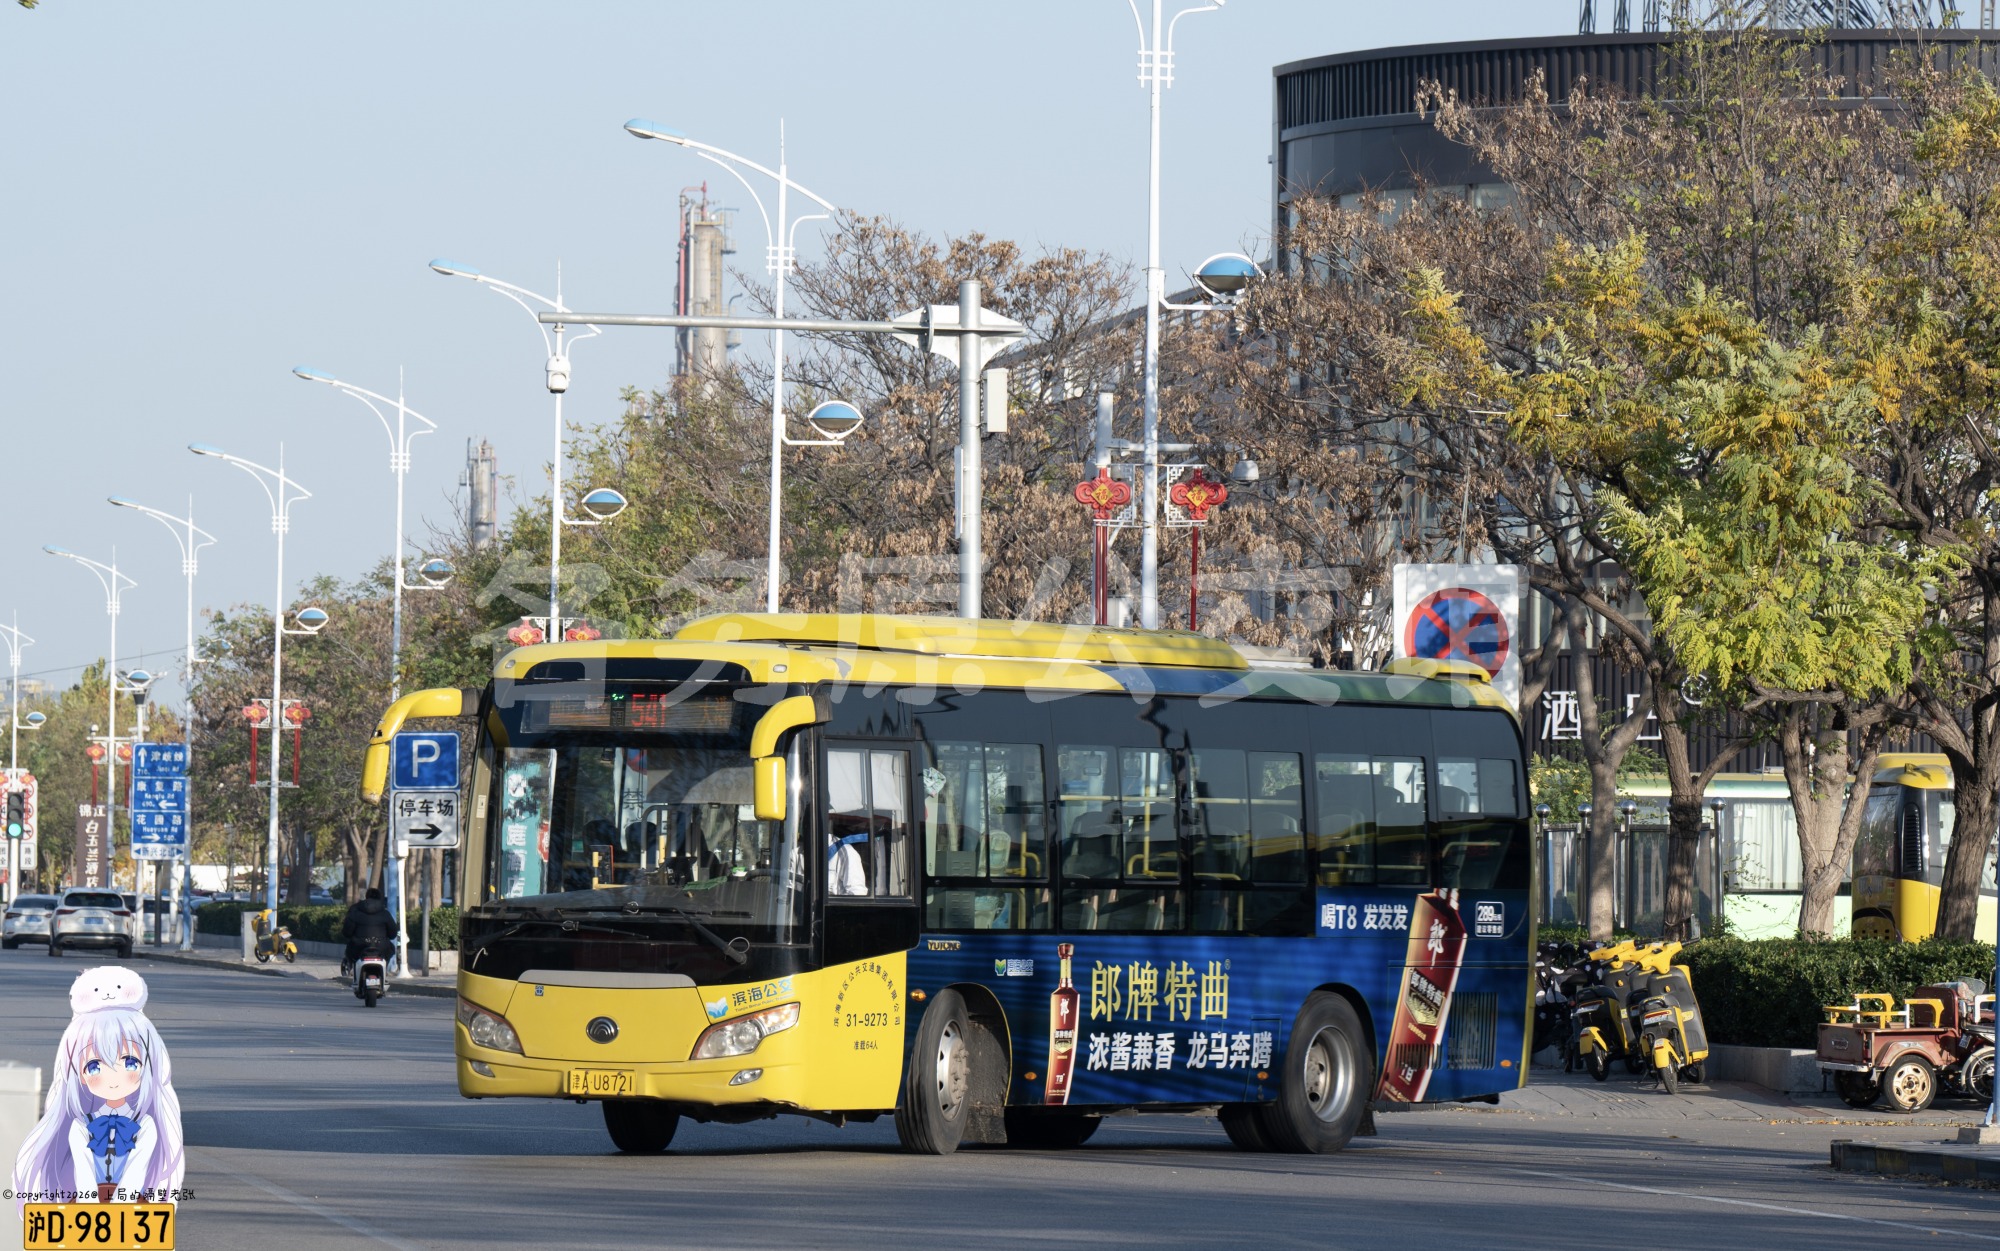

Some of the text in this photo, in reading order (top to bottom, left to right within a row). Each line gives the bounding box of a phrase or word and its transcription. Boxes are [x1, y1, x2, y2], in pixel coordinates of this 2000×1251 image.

[1095, 488, 1108, 501] 福
[412, 739, 441, 778] P
[79, 804, 107, 817] 锦江
[399, 799, 454, 817] 停车场
[136, 814, 182, 825] 花园路
[85, 820, 99, 888] 白玉兰酒店
[1321, 903, 1409, 931] 喝T8 发发发
[928, 940, 961, 951] YUTONG
[732, 979, 793, 1006] 滨海公交
[1090, 959, 1230, 1022] 郎牌特曲
[846, 1013, 888, 1027] 31-9273
[854, 1040, 878, 1051] 准载64人
[1086, 1031, 1273, 1071] 浓酱兼香 龙马奔腾
